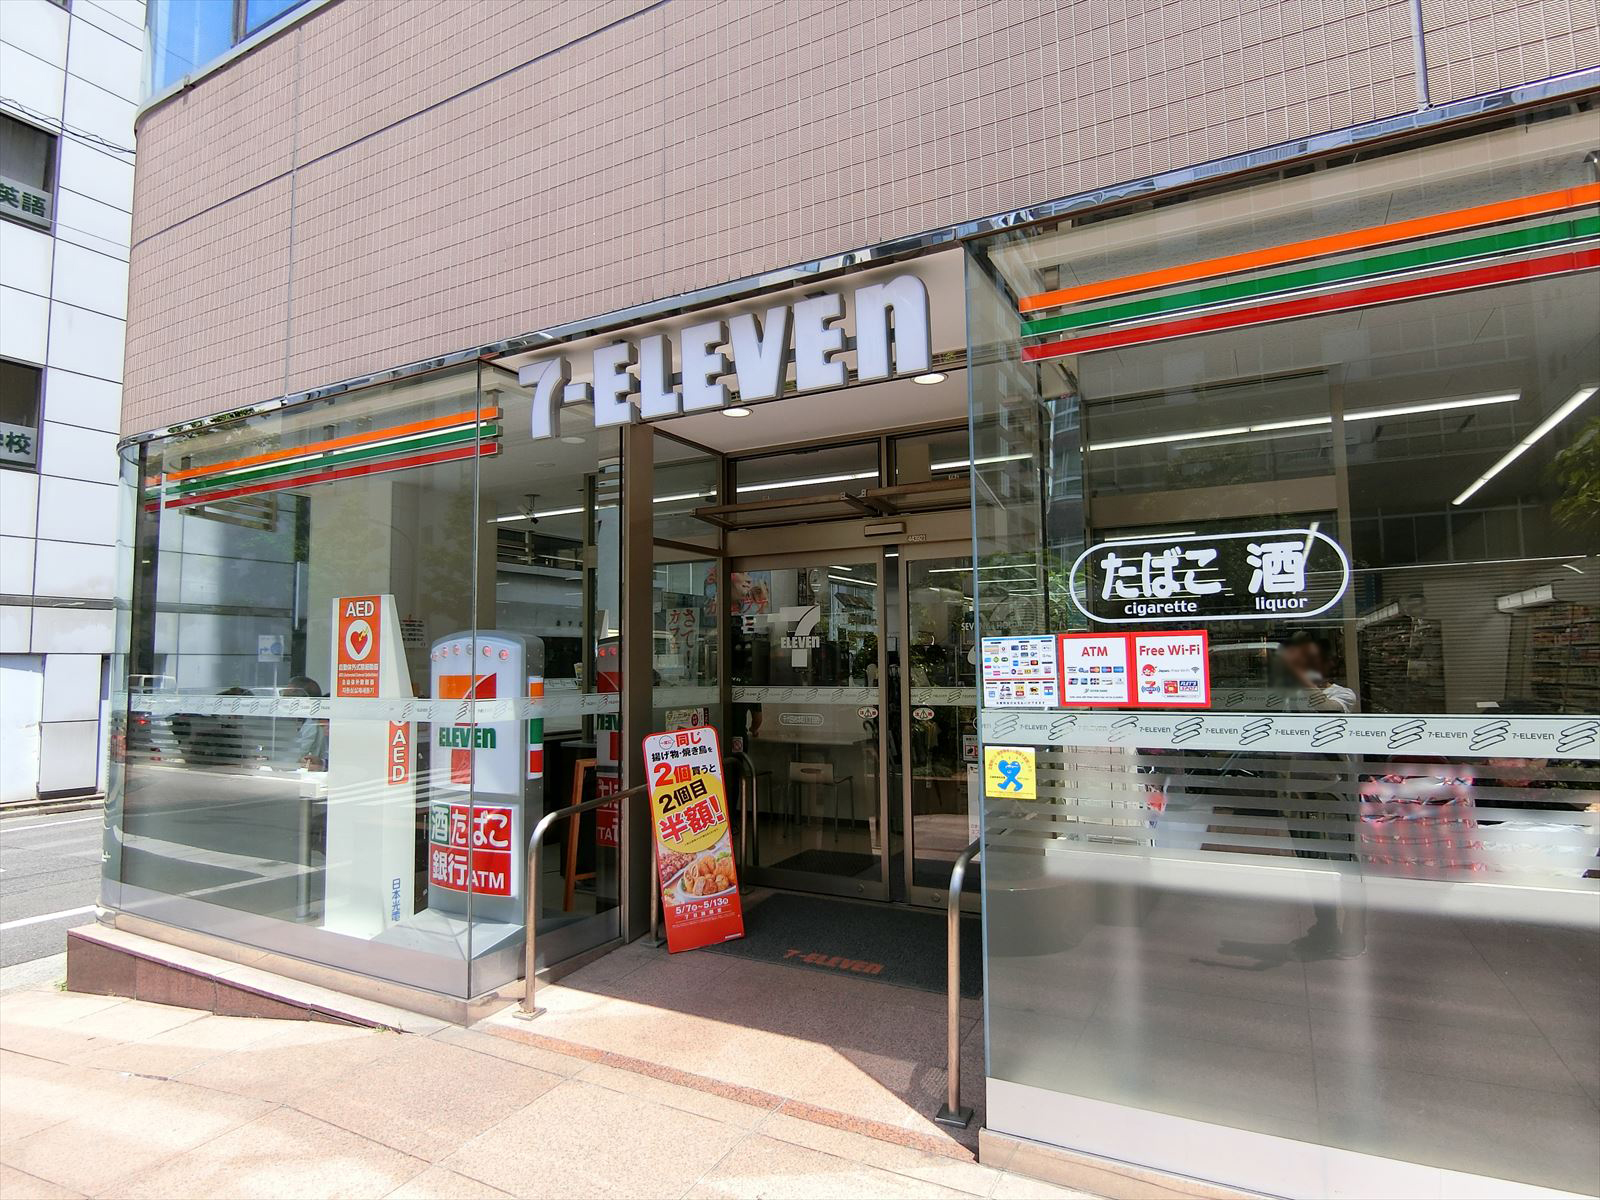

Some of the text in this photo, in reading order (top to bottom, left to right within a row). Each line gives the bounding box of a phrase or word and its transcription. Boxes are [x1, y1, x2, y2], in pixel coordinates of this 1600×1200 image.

[0, 183, 46, 217] 英語
[0, 432, 37, 456] 校
[1100, 541, 1305, 600] たばこ 酒
[345, 600, 374, 618] AED
[1124, 596, 1308, 615] cigarette liquor
[1081, 646, 1108, 657] ATM
[1139, 644, 1200, 656] Free Wi-Fi
[676, 731, 702, 747] 同じ
[391, 735, 408, 783] AED
[658, 778, 708, 813] 2個目
[431, 806, 509, 847] 酒 たばこ
[391, 877, 401, 922] 日本光電
